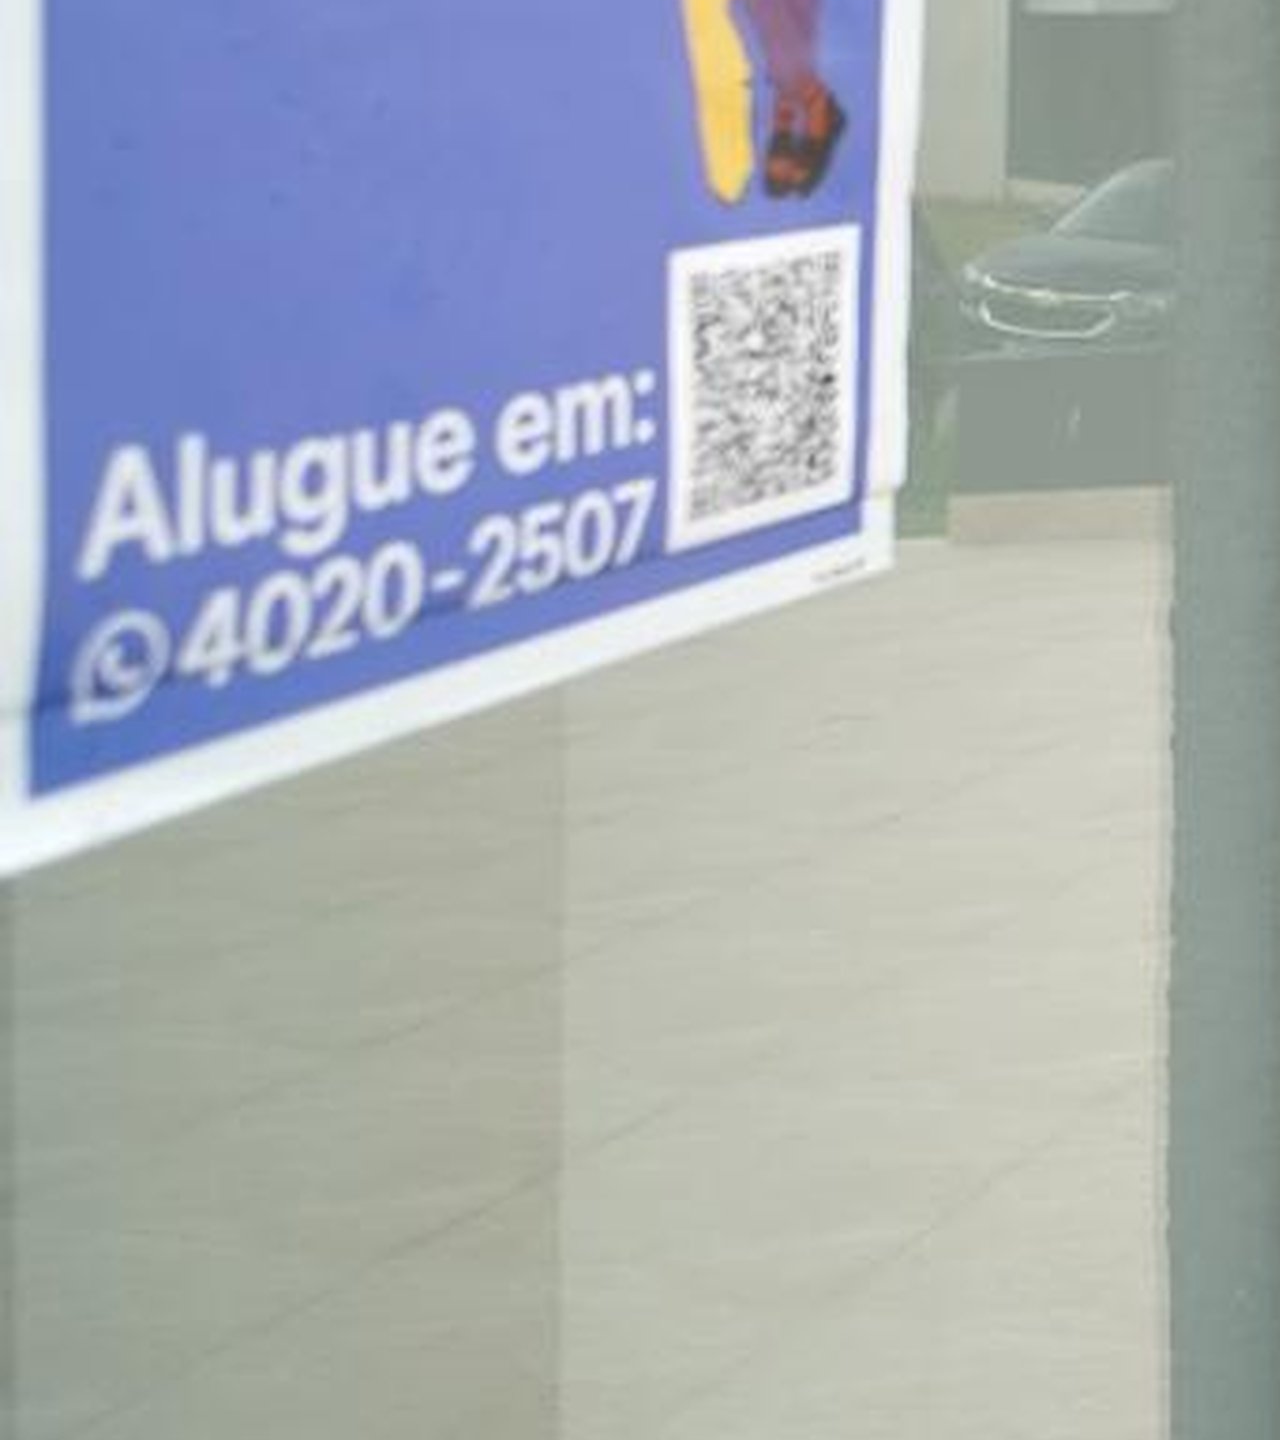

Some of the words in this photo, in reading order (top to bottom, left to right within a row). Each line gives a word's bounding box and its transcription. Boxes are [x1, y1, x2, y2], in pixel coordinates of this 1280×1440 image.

[78, 405, 475, 581] Alugue
[495, 369, 658, 475] em:
[176, 479, 658, 688] 4020-2507
